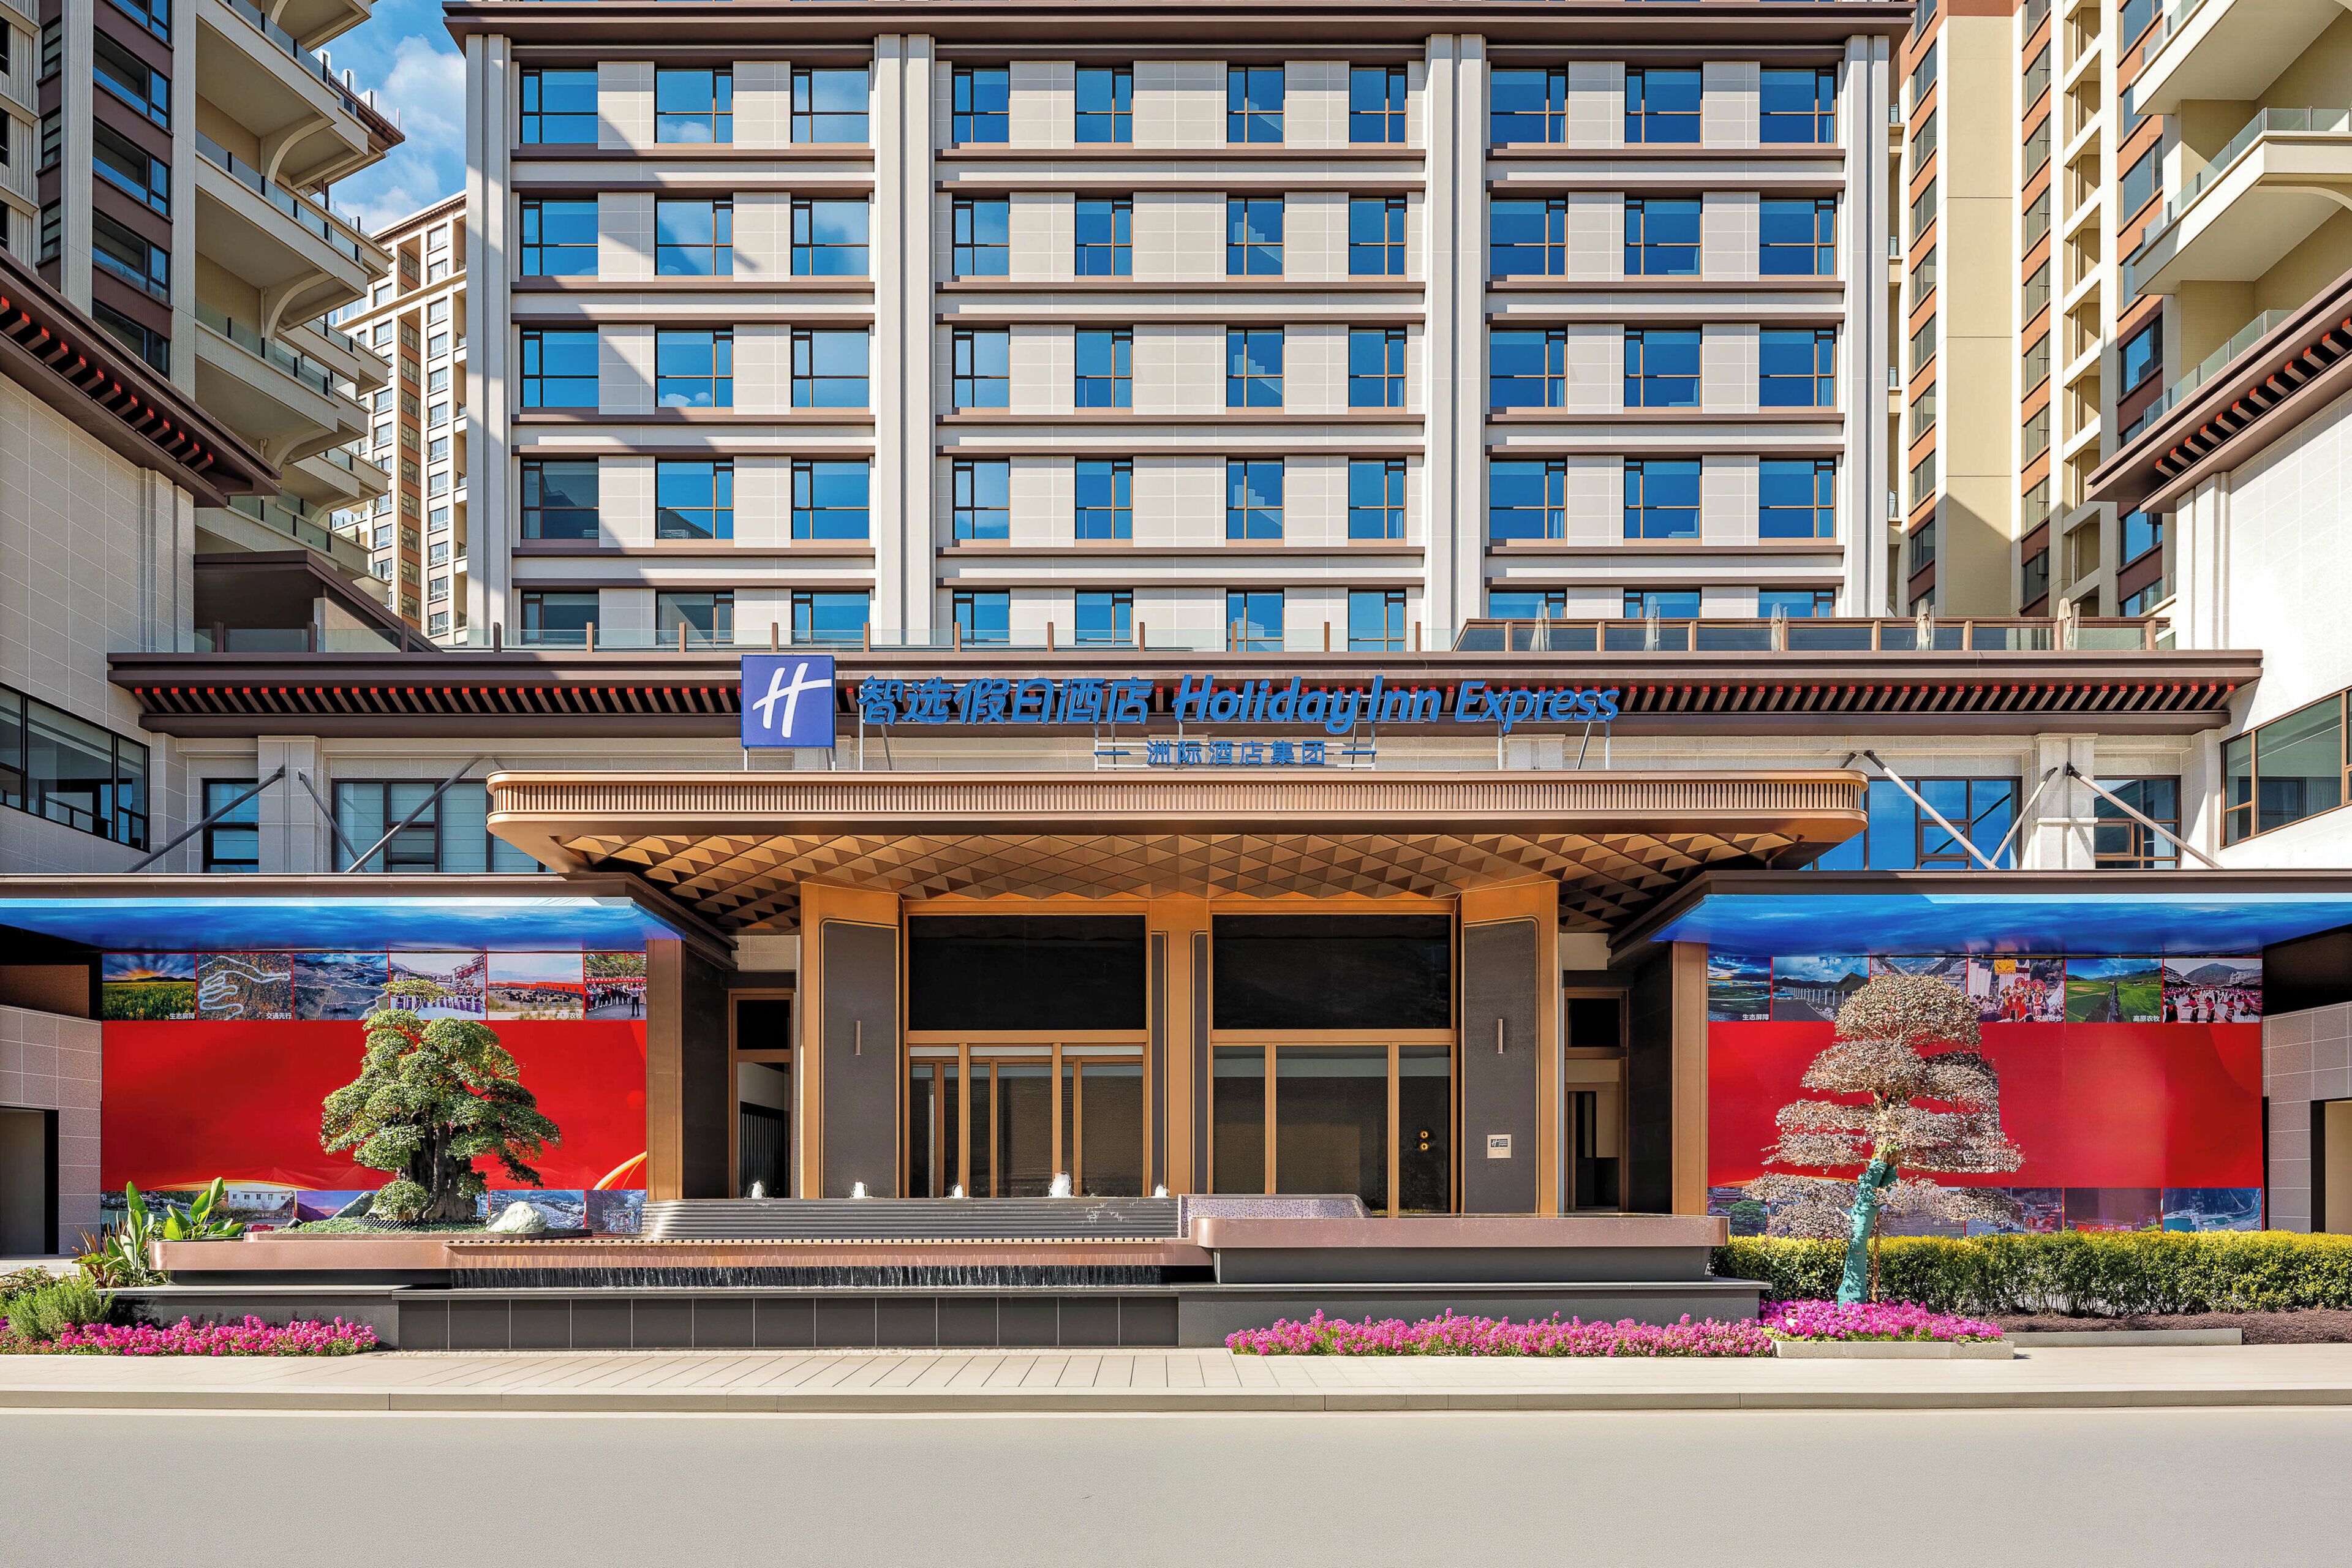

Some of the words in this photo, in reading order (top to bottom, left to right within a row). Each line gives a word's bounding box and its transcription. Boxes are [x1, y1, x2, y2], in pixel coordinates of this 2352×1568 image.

[858, 674, 1154, 726] 智选假日酒店
[1171, 674, 1357, 734] Holiday
[1366, 675, 1442, 723] Inn
[1455, 680, 1619, 733] Express
[1147, 739, 1325, 766] 洲际酒店集团
